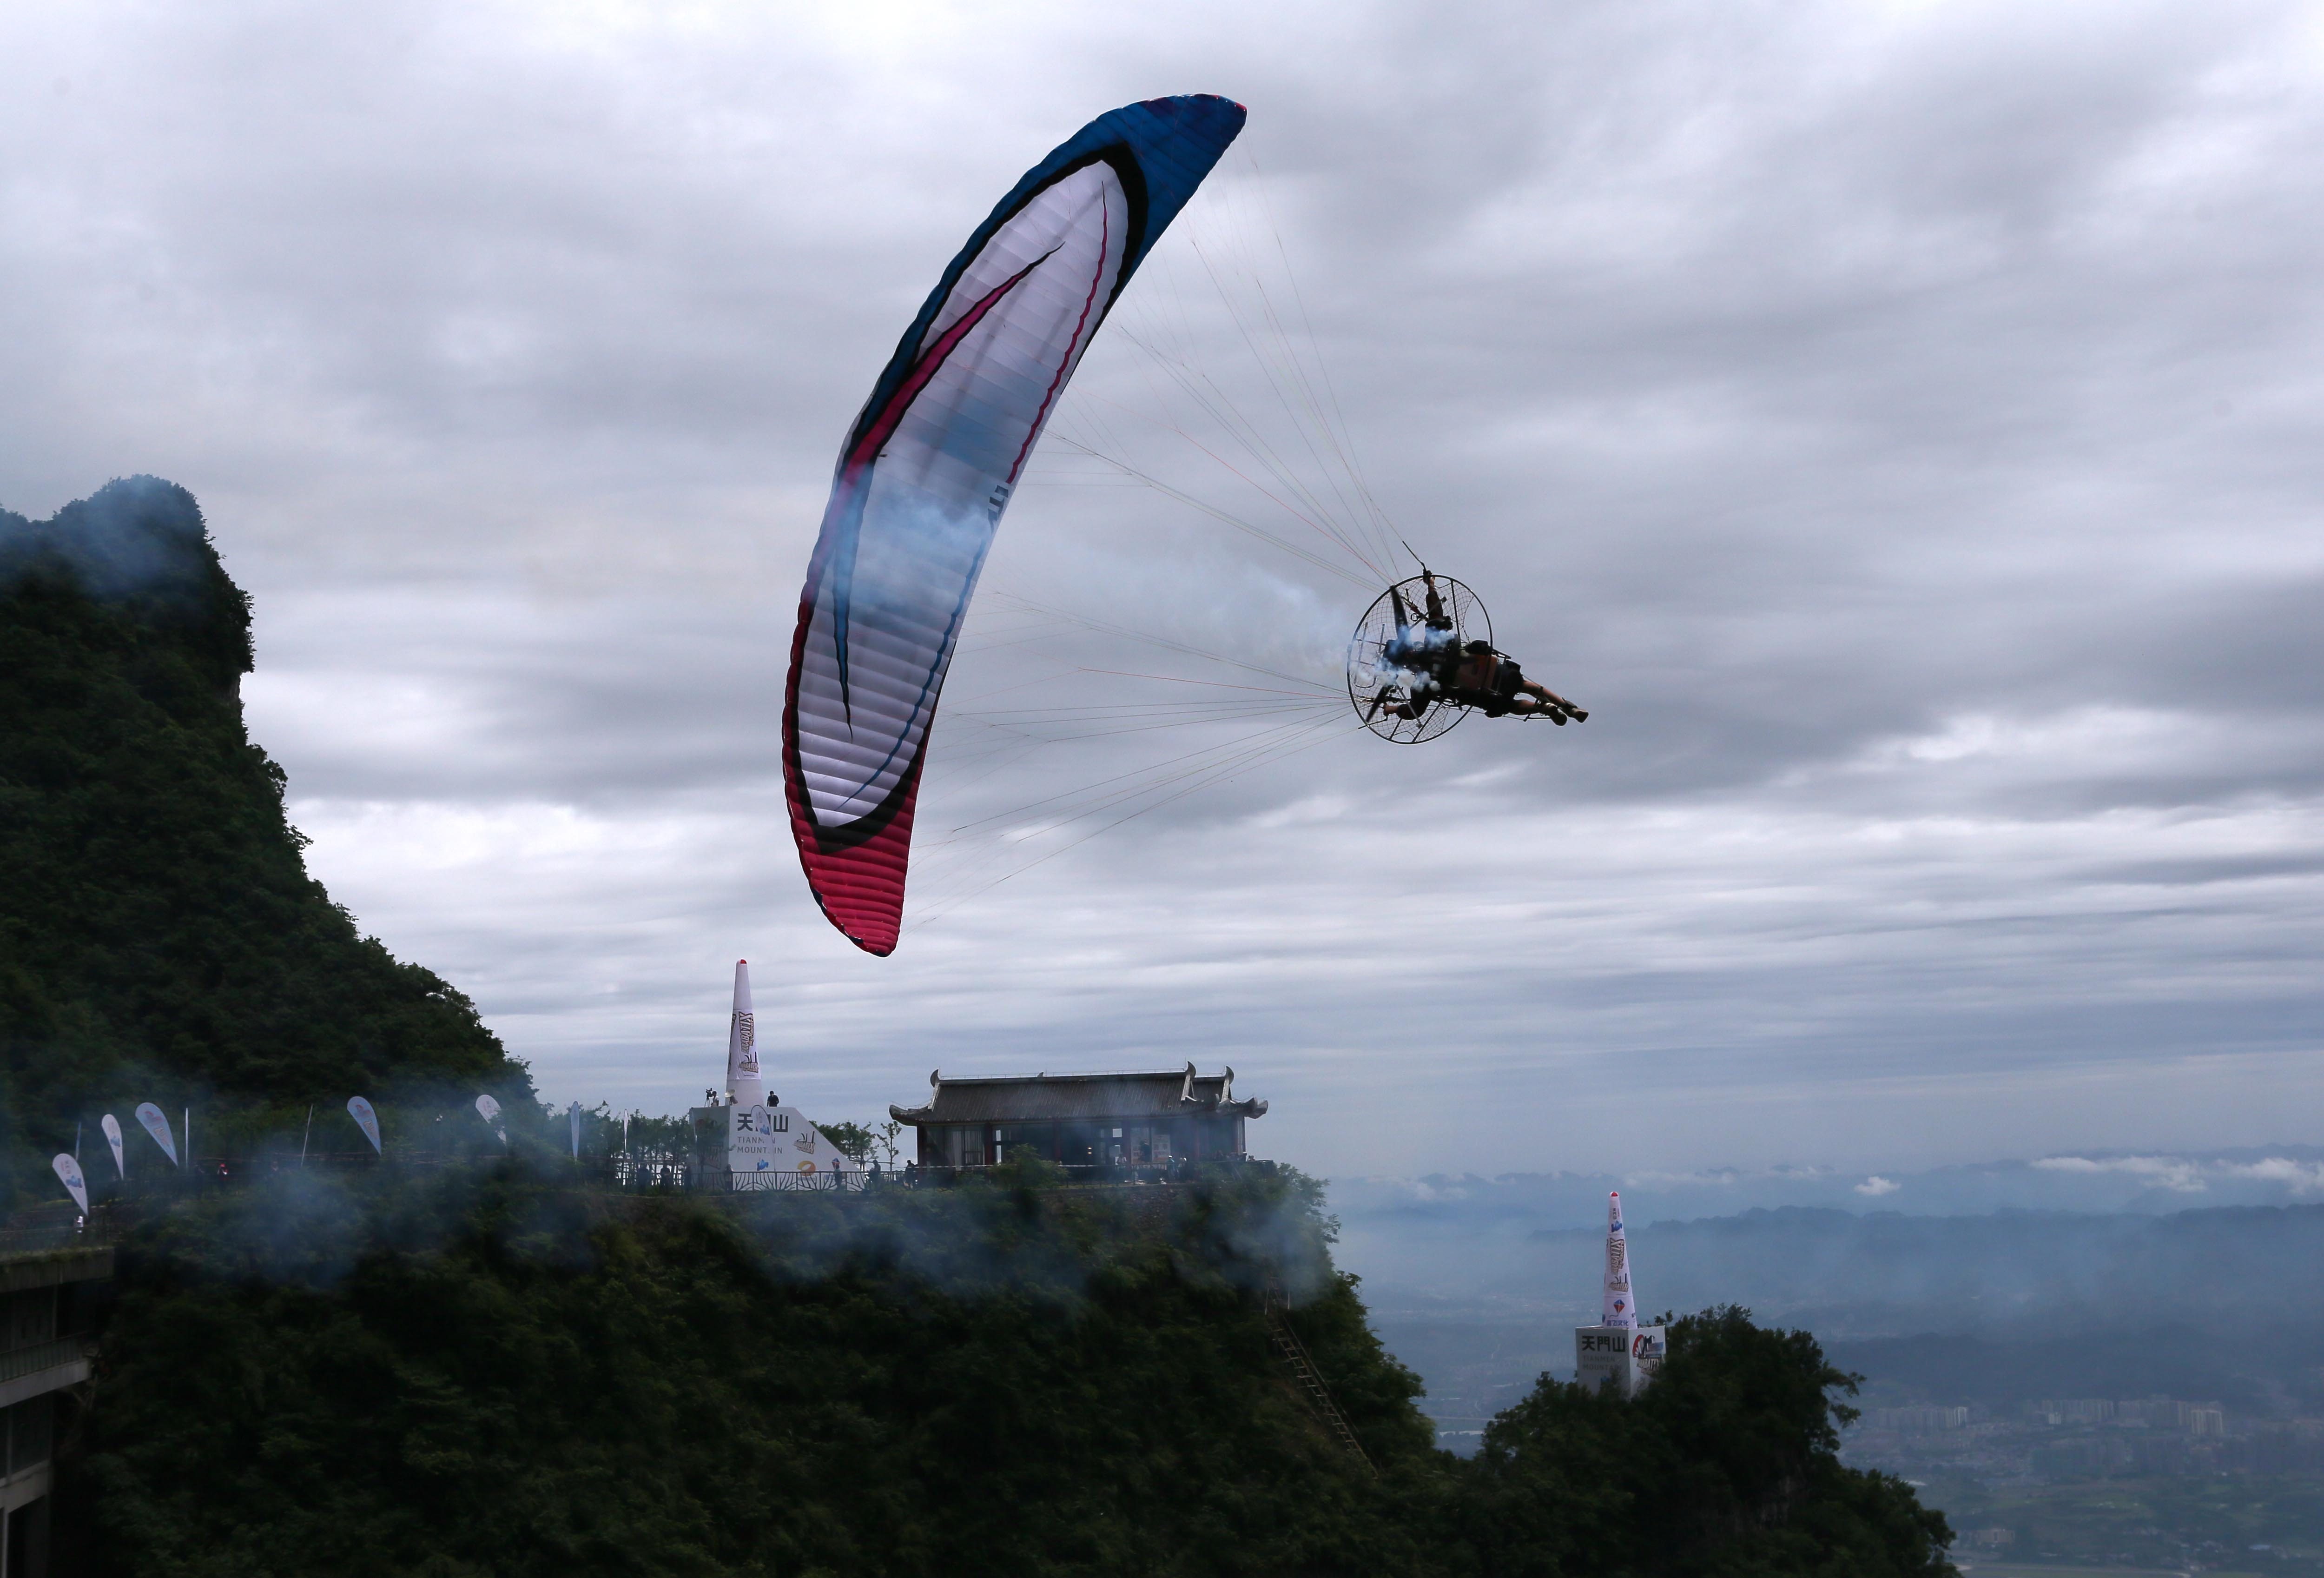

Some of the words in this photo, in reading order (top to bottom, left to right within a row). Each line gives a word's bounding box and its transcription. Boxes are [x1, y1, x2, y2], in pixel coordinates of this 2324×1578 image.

[737, 1113, 788, 1132] 天山
[1582, 1335, 1625, 1352] 天門山
